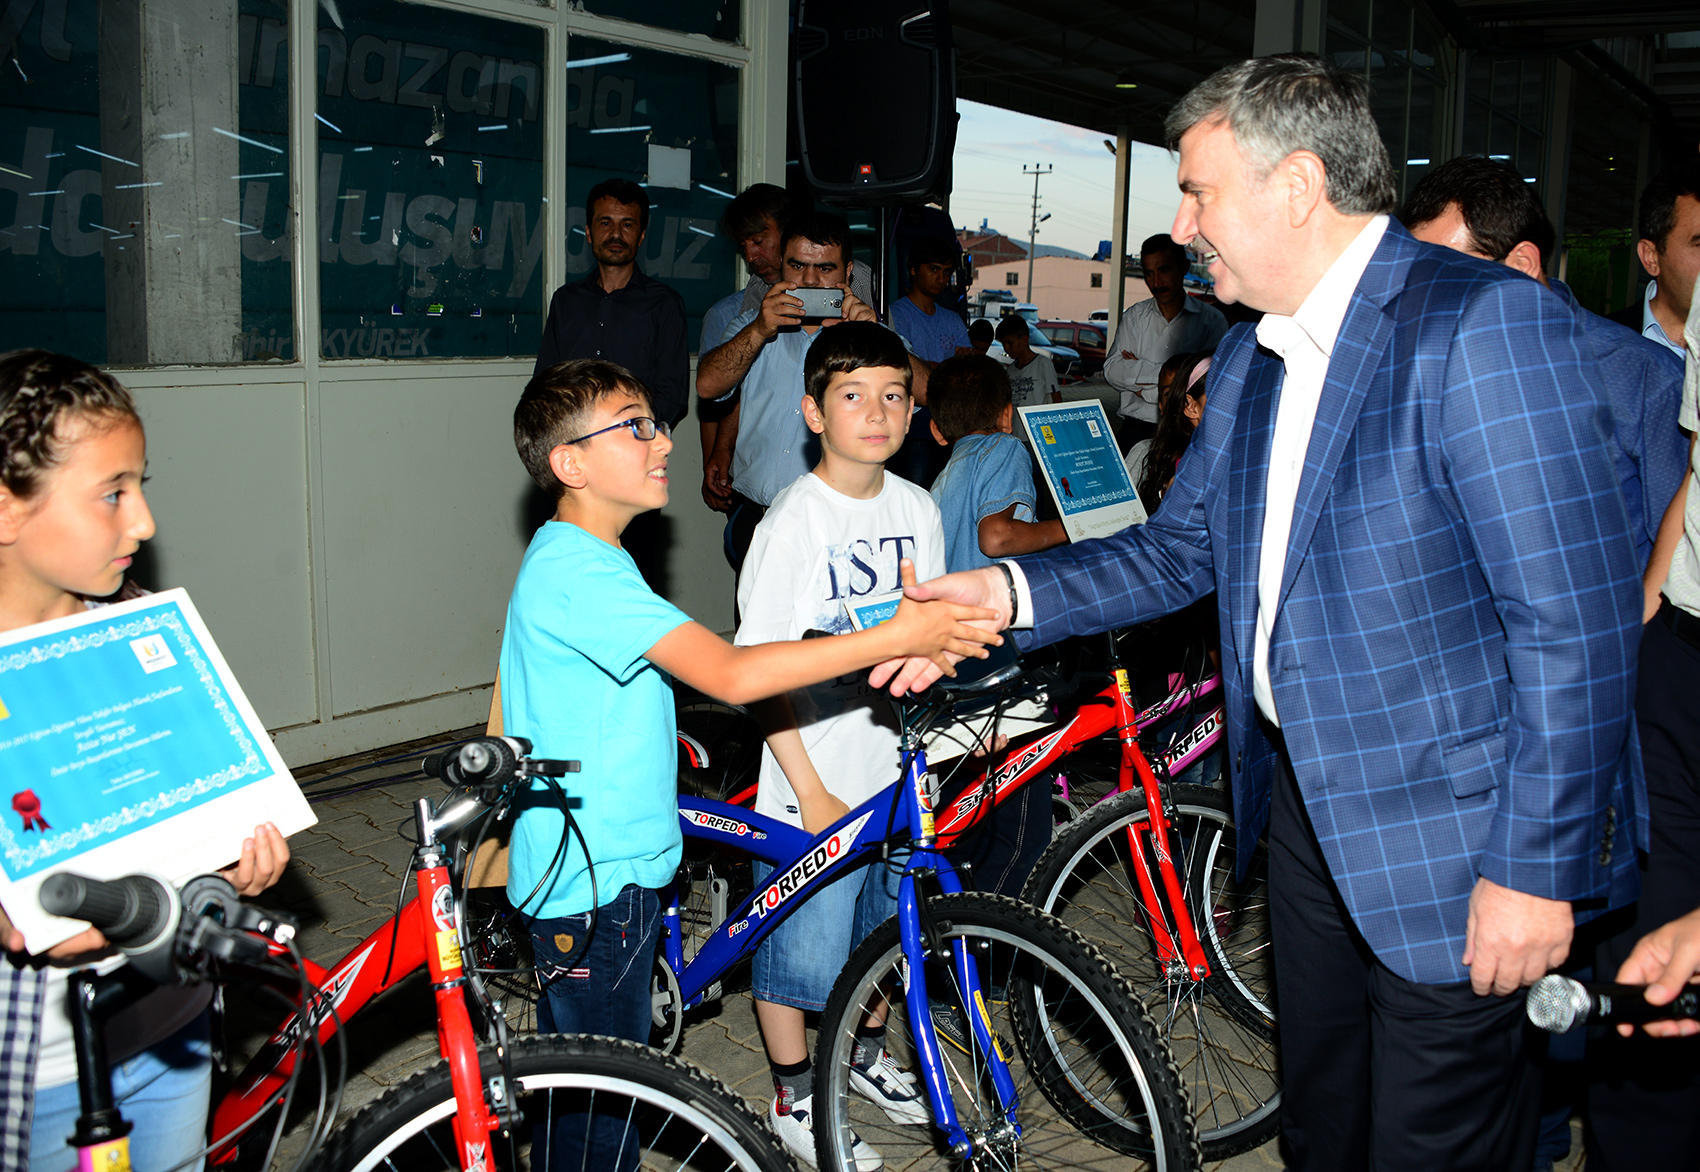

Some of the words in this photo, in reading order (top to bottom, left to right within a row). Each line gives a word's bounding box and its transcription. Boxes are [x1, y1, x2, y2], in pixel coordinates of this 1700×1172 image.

[844, 26, 884, 42] EON
[321, 320, 432, 357] KYÜREK
[693, 812, 747, 835] TORPEDO
[755, 836, 841, 917] TORPEDO
[729, 920, 749, 938] Fire
